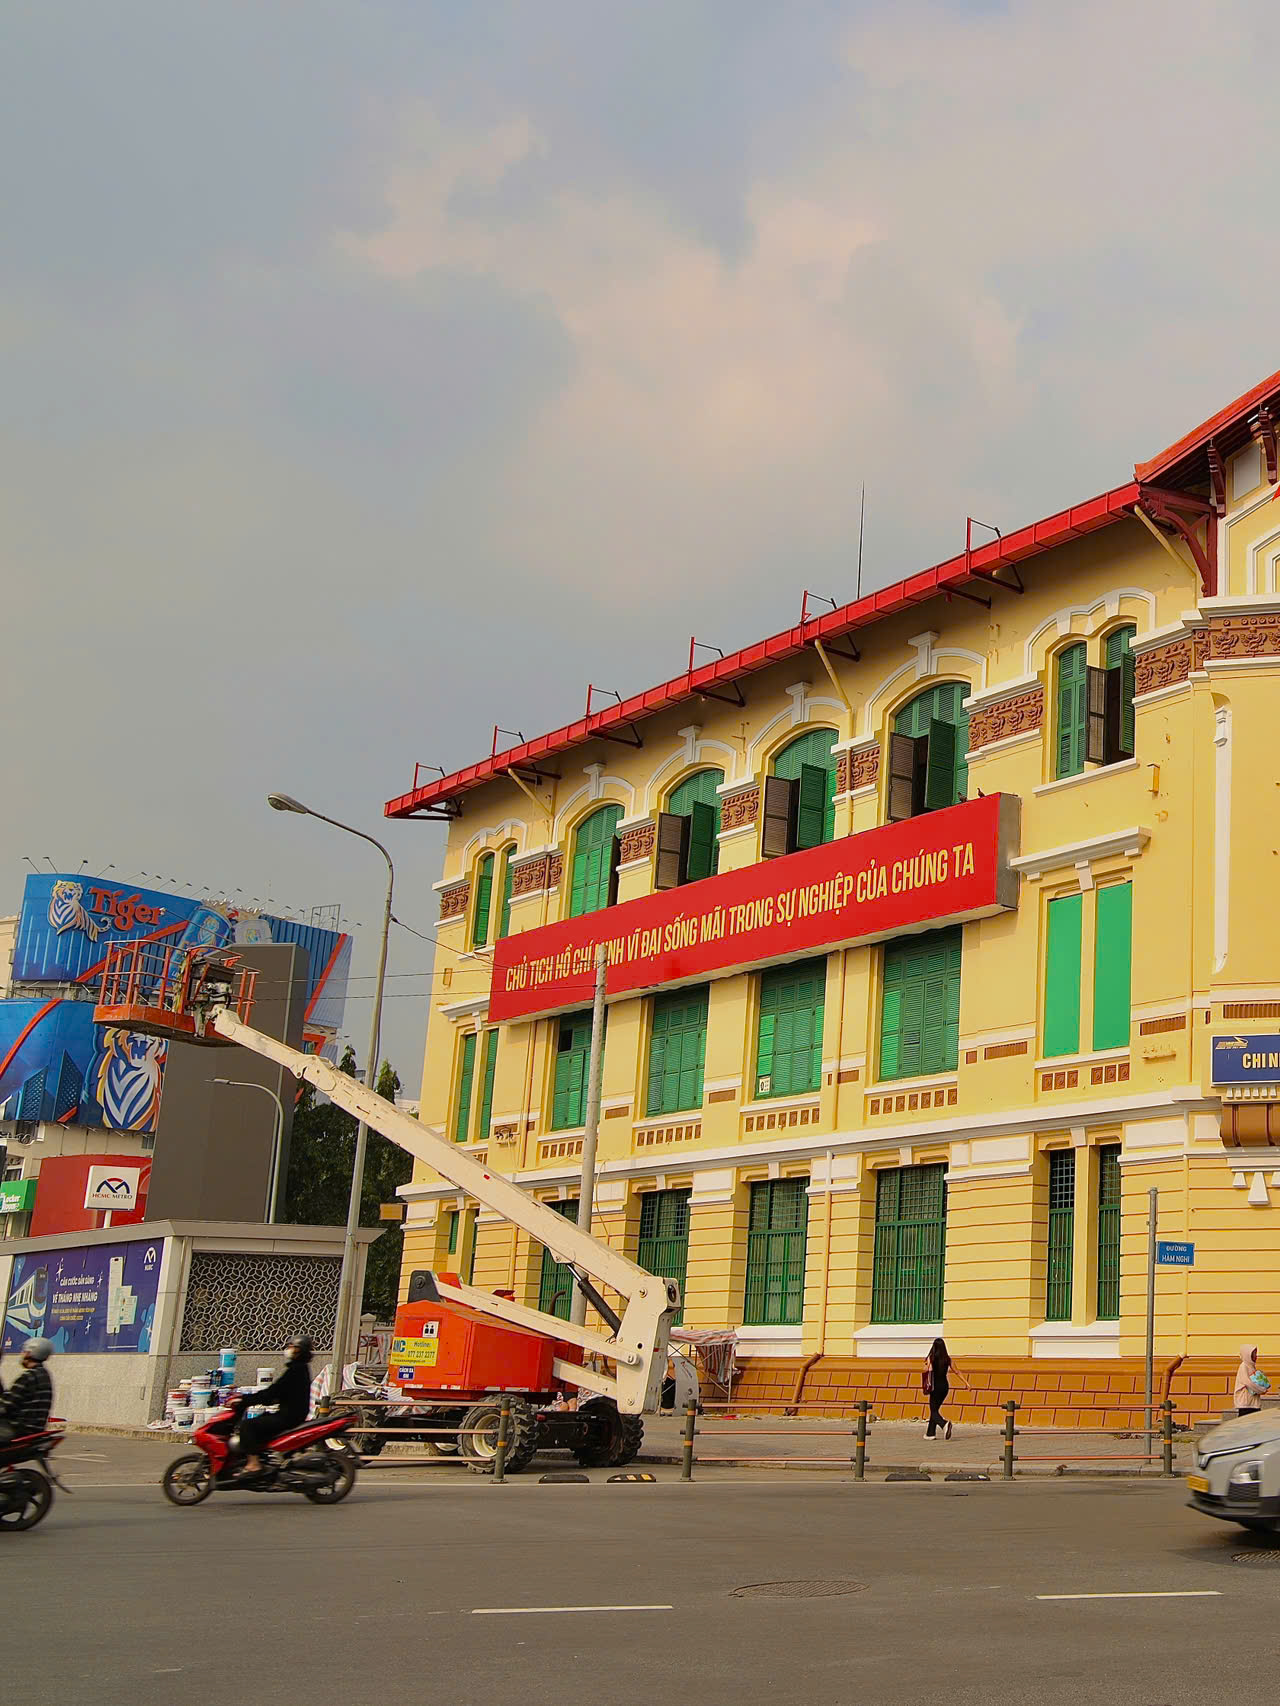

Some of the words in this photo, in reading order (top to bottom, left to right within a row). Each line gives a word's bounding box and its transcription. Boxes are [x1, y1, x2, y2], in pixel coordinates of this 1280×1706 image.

[89, 887, 161, 930] Tiger
[506, 955, 528, 992] CHỦ
[529, 954, 553, 989] TỊCH
[554, 943, 573, 981] HỒ
[573, 939, 593, 976] CHÍ
[627, 928, 641, 961] VĨ
[641, 928, 661, 962] ĐẠI
[664, 912, 698, 952] SỐNG
[700, 905, 727, 944] MÃI
[728, 896, 774, 936] TRONG
[776, 888, 797, 927] SỰ
[798, 871, 854, 915] NGHIỆP
[856, 858, 888, 903] CỦA
[892, 848, 948, 894] CHÚNG
[952, 842, 975, 878] TA
[1242, 1053, 1268, 1069] CHI
[1166, 1243, 1187, 1252] ĐƯỜNG
[1162, 1253, 1175, 1262] HÀM
